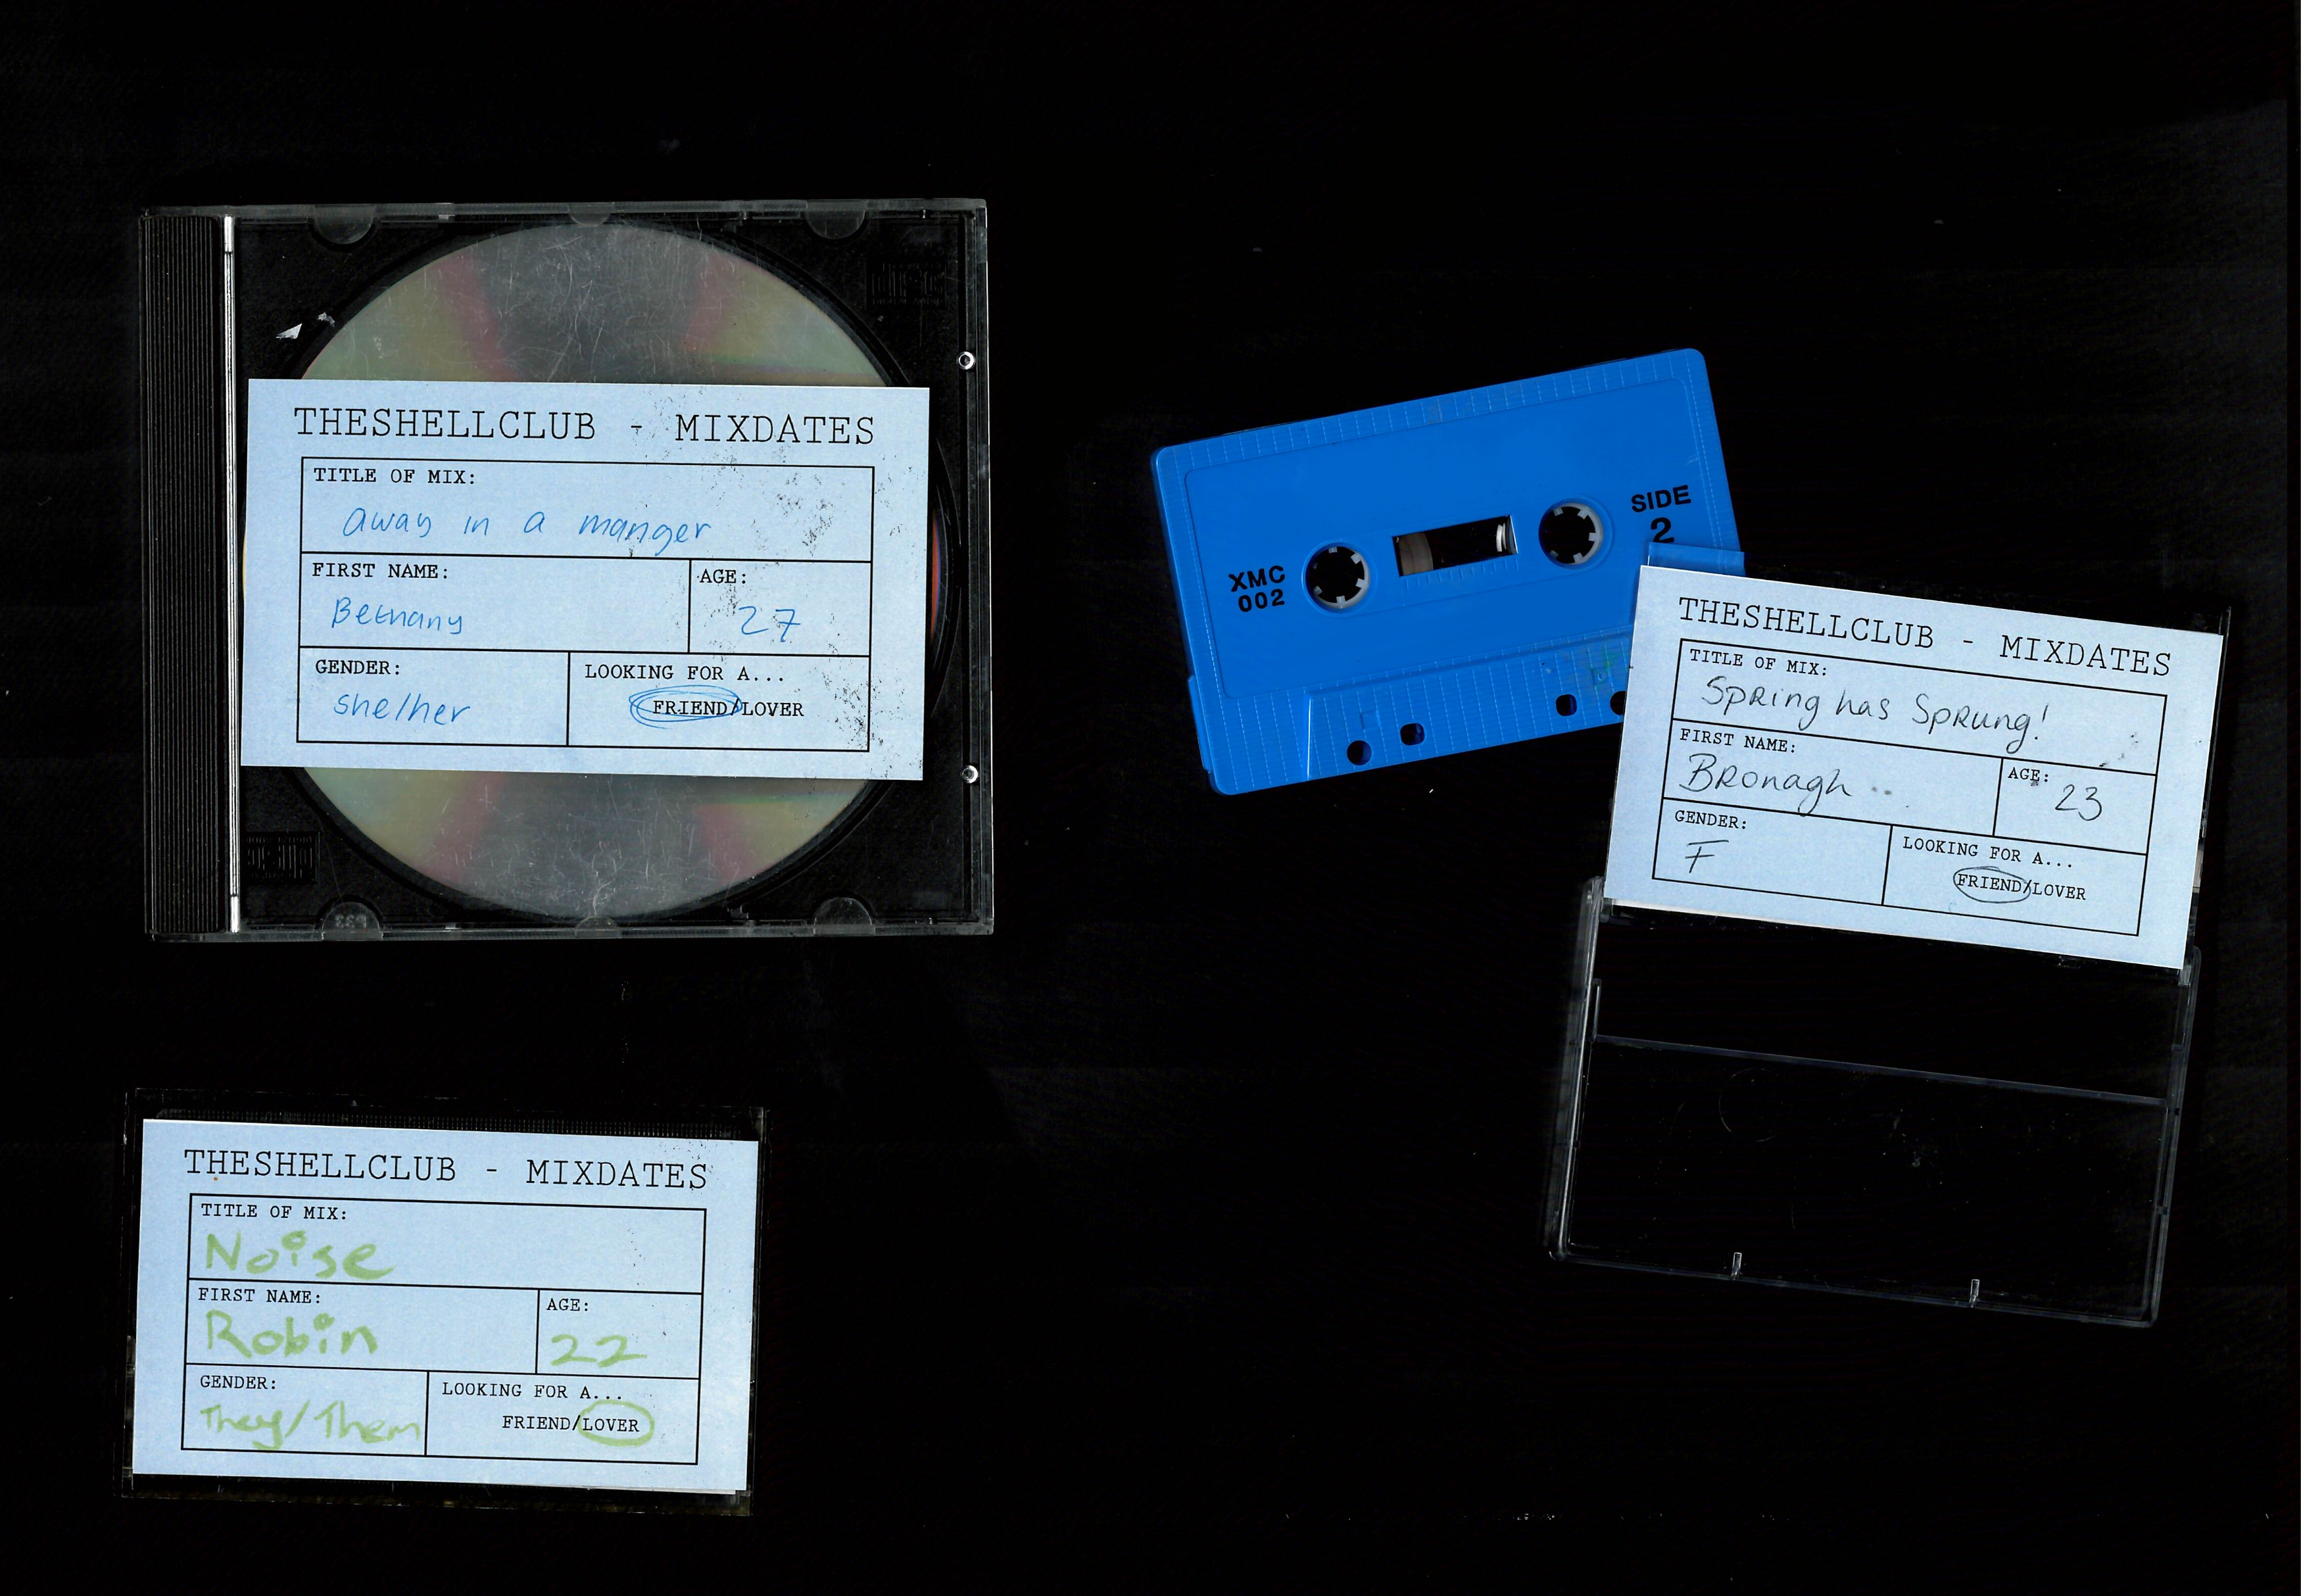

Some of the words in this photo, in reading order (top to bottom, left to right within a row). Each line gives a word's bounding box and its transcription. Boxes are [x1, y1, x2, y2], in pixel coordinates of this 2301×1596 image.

[294, 407, 595, 440] THESHELLCLUB
[675, 414, 873, 445] MIXDATES
[313, 468, 377, 483] TITLE
[391, 469, 415, 483] OF
[427, 470, 474, 485] MIX:
[1631, 484, 1691, 513] SIDE
[341, 506, 432, 539] away
[464, 516, 490, 535] in
[523, 510, 546, 534] a
[578, 514, 712, 556] manger
[1650, 517, 1675, 544] 2
[312, 562, 375, 578] FIRST
[387, 563, 447, 579] NAME:
[699, 568, 746, 585] AGE:
[1228, 565, 1286, 592] XMC
[1238, 588, 1285, 612] 002
[738, 605, 800, 642] 27
[1679, 596, 1935, 649] THESHELLCLUB
[1999, 635, 2171, 676] MIXDATES
[315, 659, 400, 675] GENDER:
[585, 664, 674, 680] LOOKING
[687, 665, 724, 681] FOR
[737, 665, 783, 682] A...
[1689, 648, 1744, 667] TITLE
[1755, 656, 1776, 670] OF
[1786, 660, 1828, 676] MIX:
[333, 692, 471, 726] she/her
[652, 698, 804, 717] FRIEND/LOVER
[1835, 689, 1890, 721] has
[1680, 728, 1735, 746] FIRST
[1743, 736, 1796, 753] NAME:
[2007, 767, 2048, 783] AGE:
[2054, 784, 2102, 822] 23
[1674, 810, 1747, 830] GENDER:
[1684, 839, 1730, 874] F
[1902, 836, 1979, 857] LOOKING
[1989, 846, 2022, 862] FOR
[2031, 852, 2071, 868] A...
[1956, 873, 2087, 901] FRIEND/LOVER
[184, 1149, 456, 1181] THESHELLCLUB
[525, 1159, 706, 1189] MIXDATES
[201, 1203, 258, 1218] TITLE
[270, 1205, 292, 1219] OF
[303, 1206, 347, 1221] MIX:
[205, 1230, 395, 1280] Noise
[198, 1287, 255, 1302] FIRST
[266, 1289, 320, 1304] NAME:
[546, 1297, 589, 1311] AGE:
[205, 1309, 379, 1360] Robin
[549, 1332, 650, 1368] 22
[200, 1375, 276, 1390] GENDER:
[442, 1382, 522, 1397] LOOKING
[534, 1384, 568, 1399] FOR
[579, 1386, 621, 1400] A...
[199, 1399, 422, 1451] They/Them
[502, 1415, 640, 1432] FRIEND/LOVER
